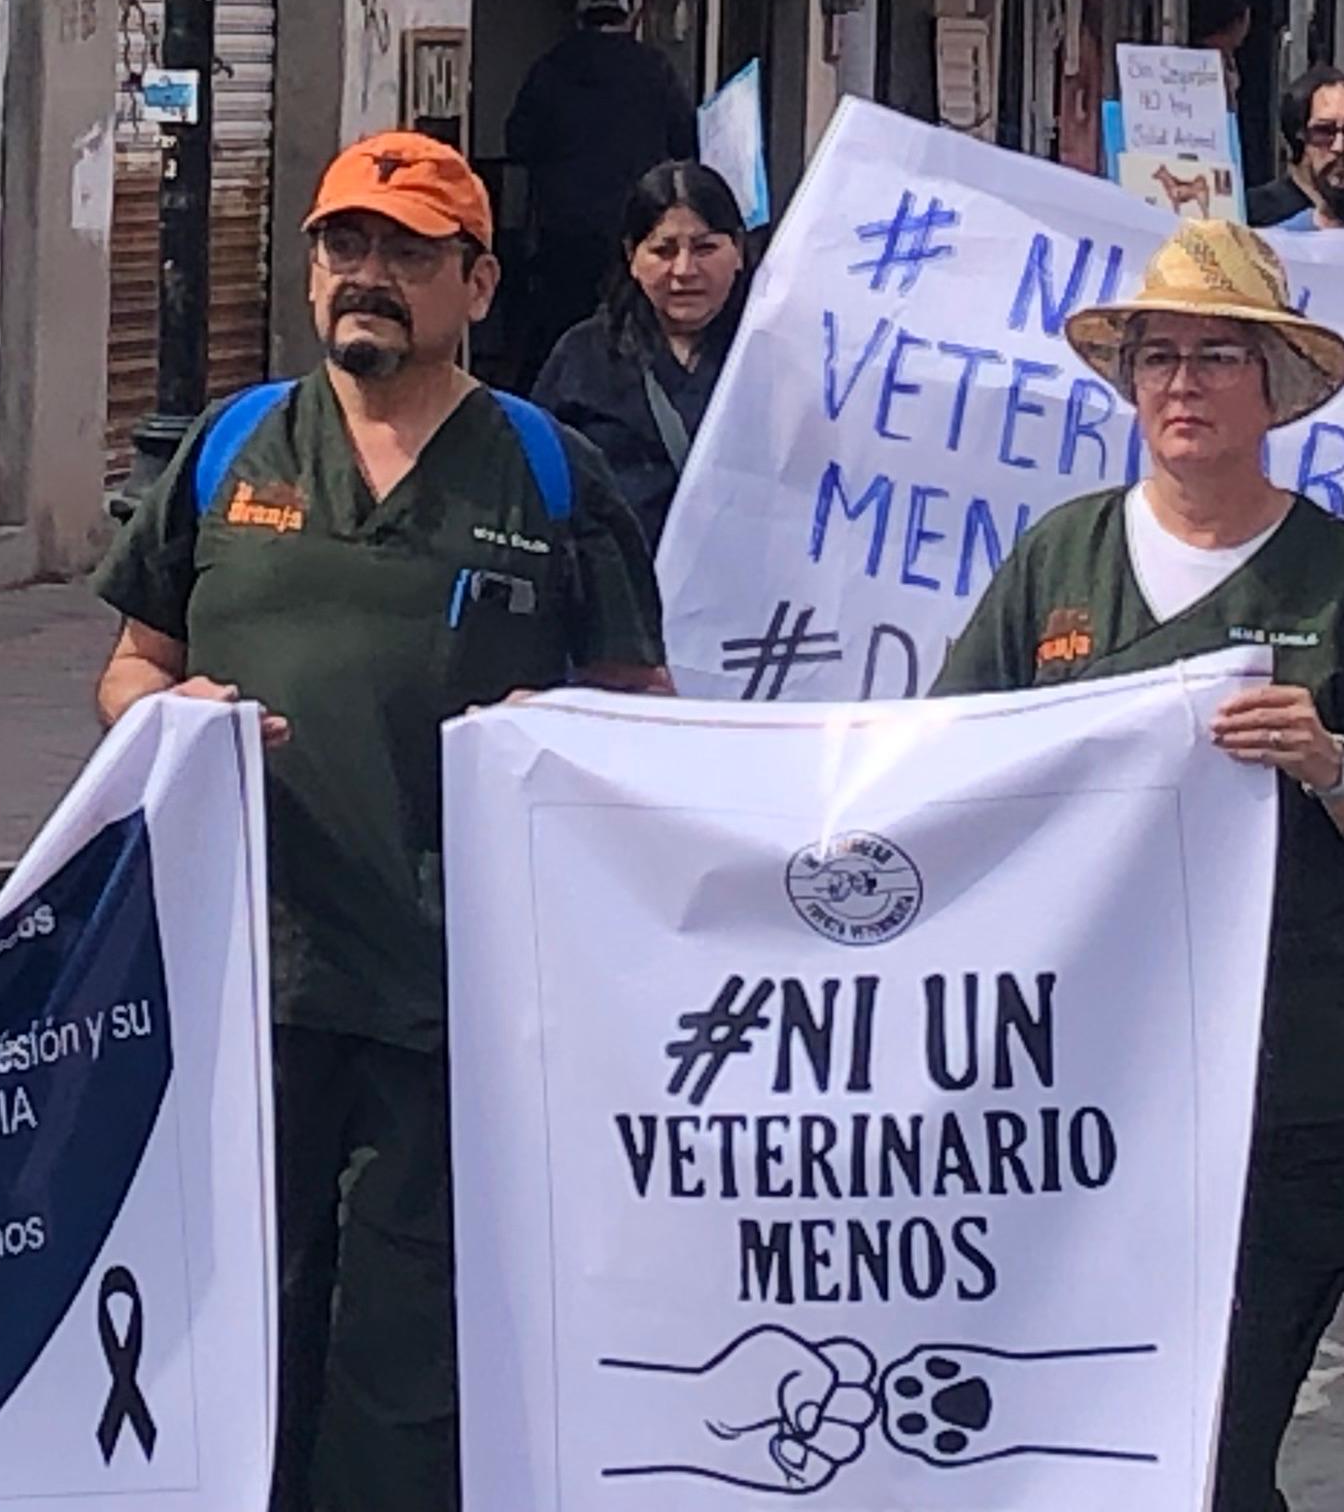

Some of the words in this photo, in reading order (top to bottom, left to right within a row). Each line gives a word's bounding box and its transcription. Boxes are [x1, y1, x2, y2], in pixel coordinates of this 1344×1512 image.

[84, 1010, 107, 1062] y
[112, 999, 153, 1042] su
[664, 972, 880, 1105] #NI
[923, 972, 1057, 1091] UN
[613, 1105, 1118, 1199] VETERINARIO
[738, 1216, 997, 1305] MENOS
